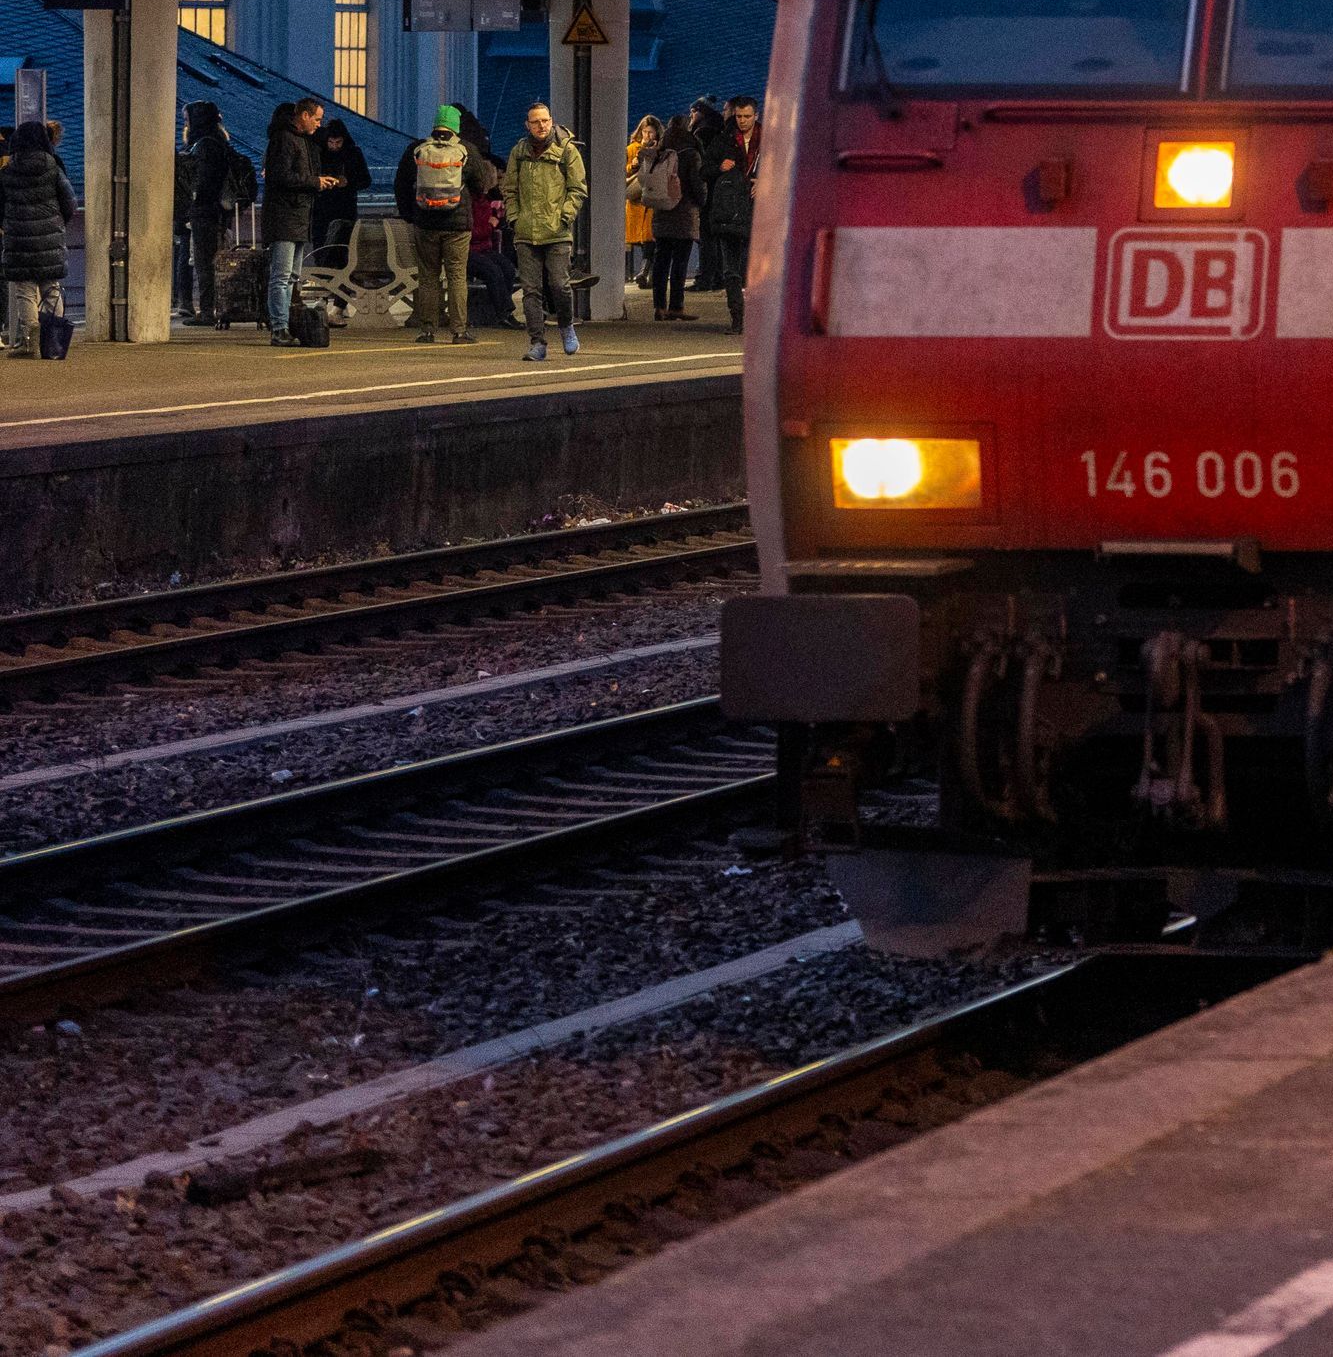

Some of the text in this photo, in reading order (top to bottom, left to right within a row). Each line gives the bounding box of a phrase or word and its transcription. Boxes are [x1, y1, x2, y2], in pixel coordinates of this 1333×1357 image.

[1128, 248, 1237, 319] DB
[1080, 449, 1301, 499] 146 006
